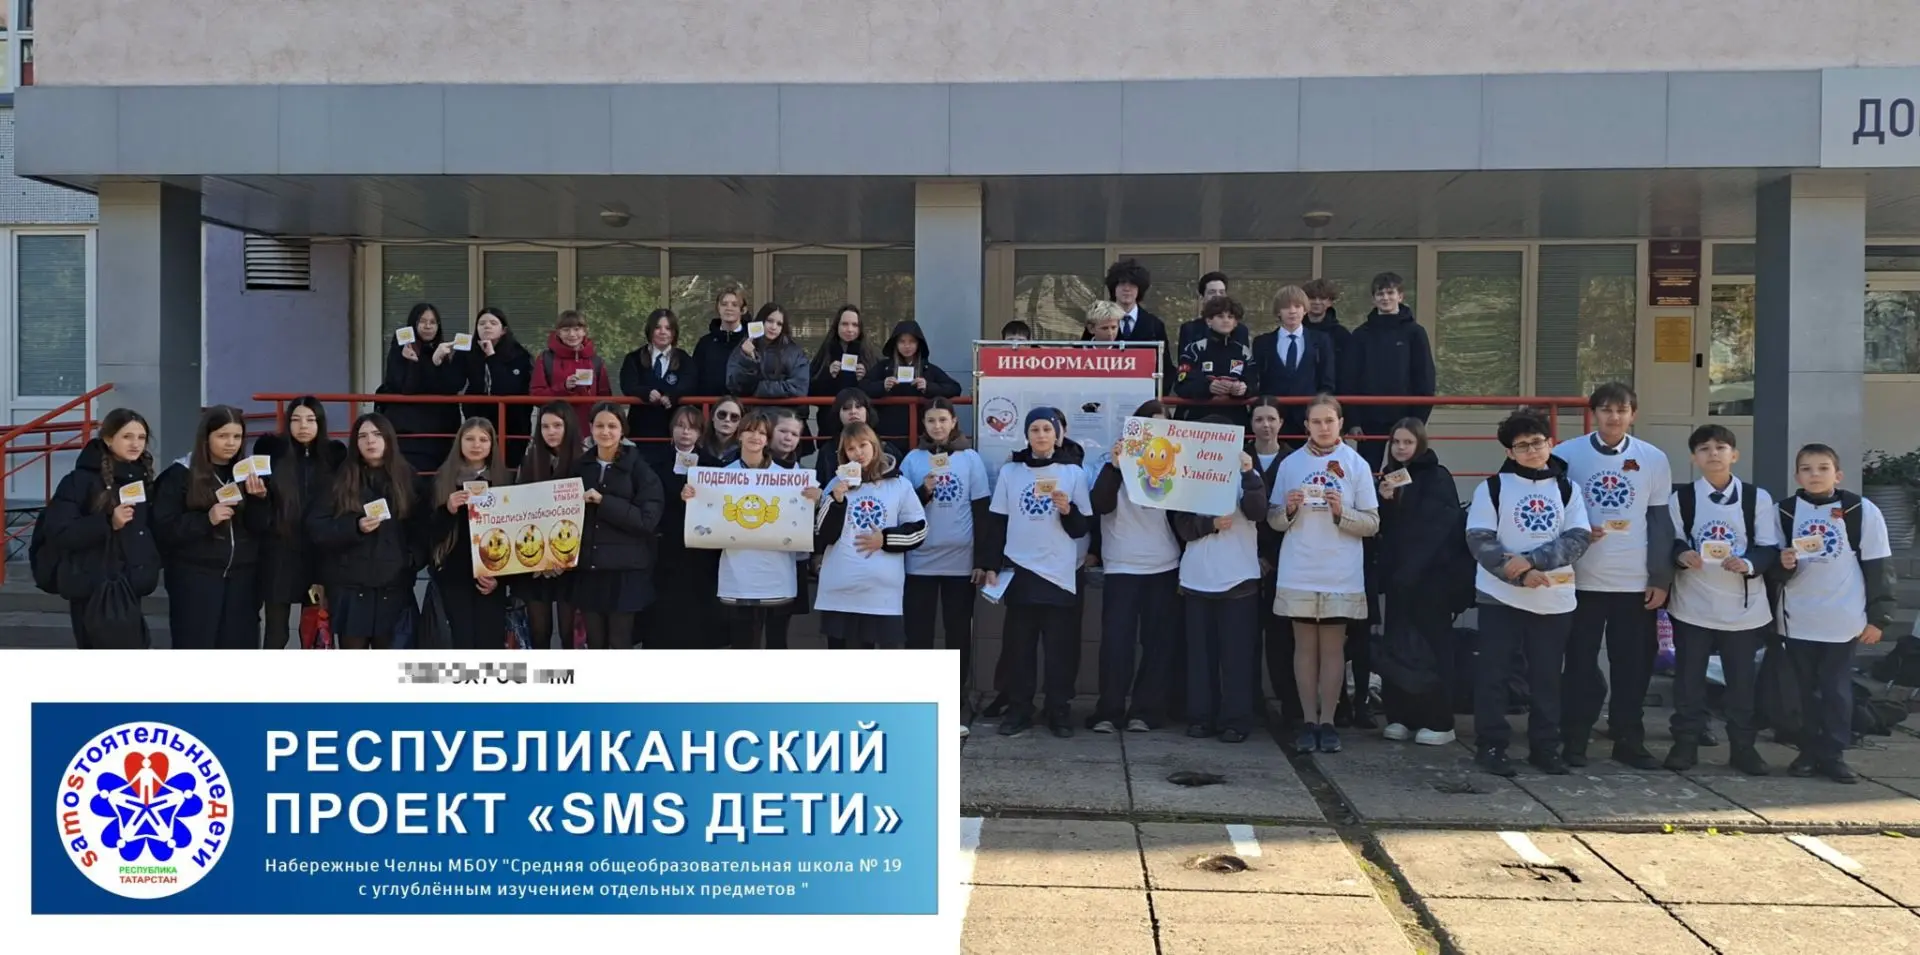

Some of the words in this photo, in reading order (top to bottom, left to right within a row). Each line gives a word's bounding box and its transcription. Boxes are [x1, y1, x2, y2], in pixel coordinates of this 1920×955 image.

[1853, 98, 1920, 145] ДО
[998, 355, 1136, 372] ИНФОРМАЦИЯ
[1167, 423, 1236, 443] Всемирный
[1196, 448, 1224, 461] день
[697, 471, 750, 487] ПОДЕЛИСЬ
[756, 472, 809, 487] УЛЫБКОЙ
[1181, 465, 1232, 483] Улыбки!
